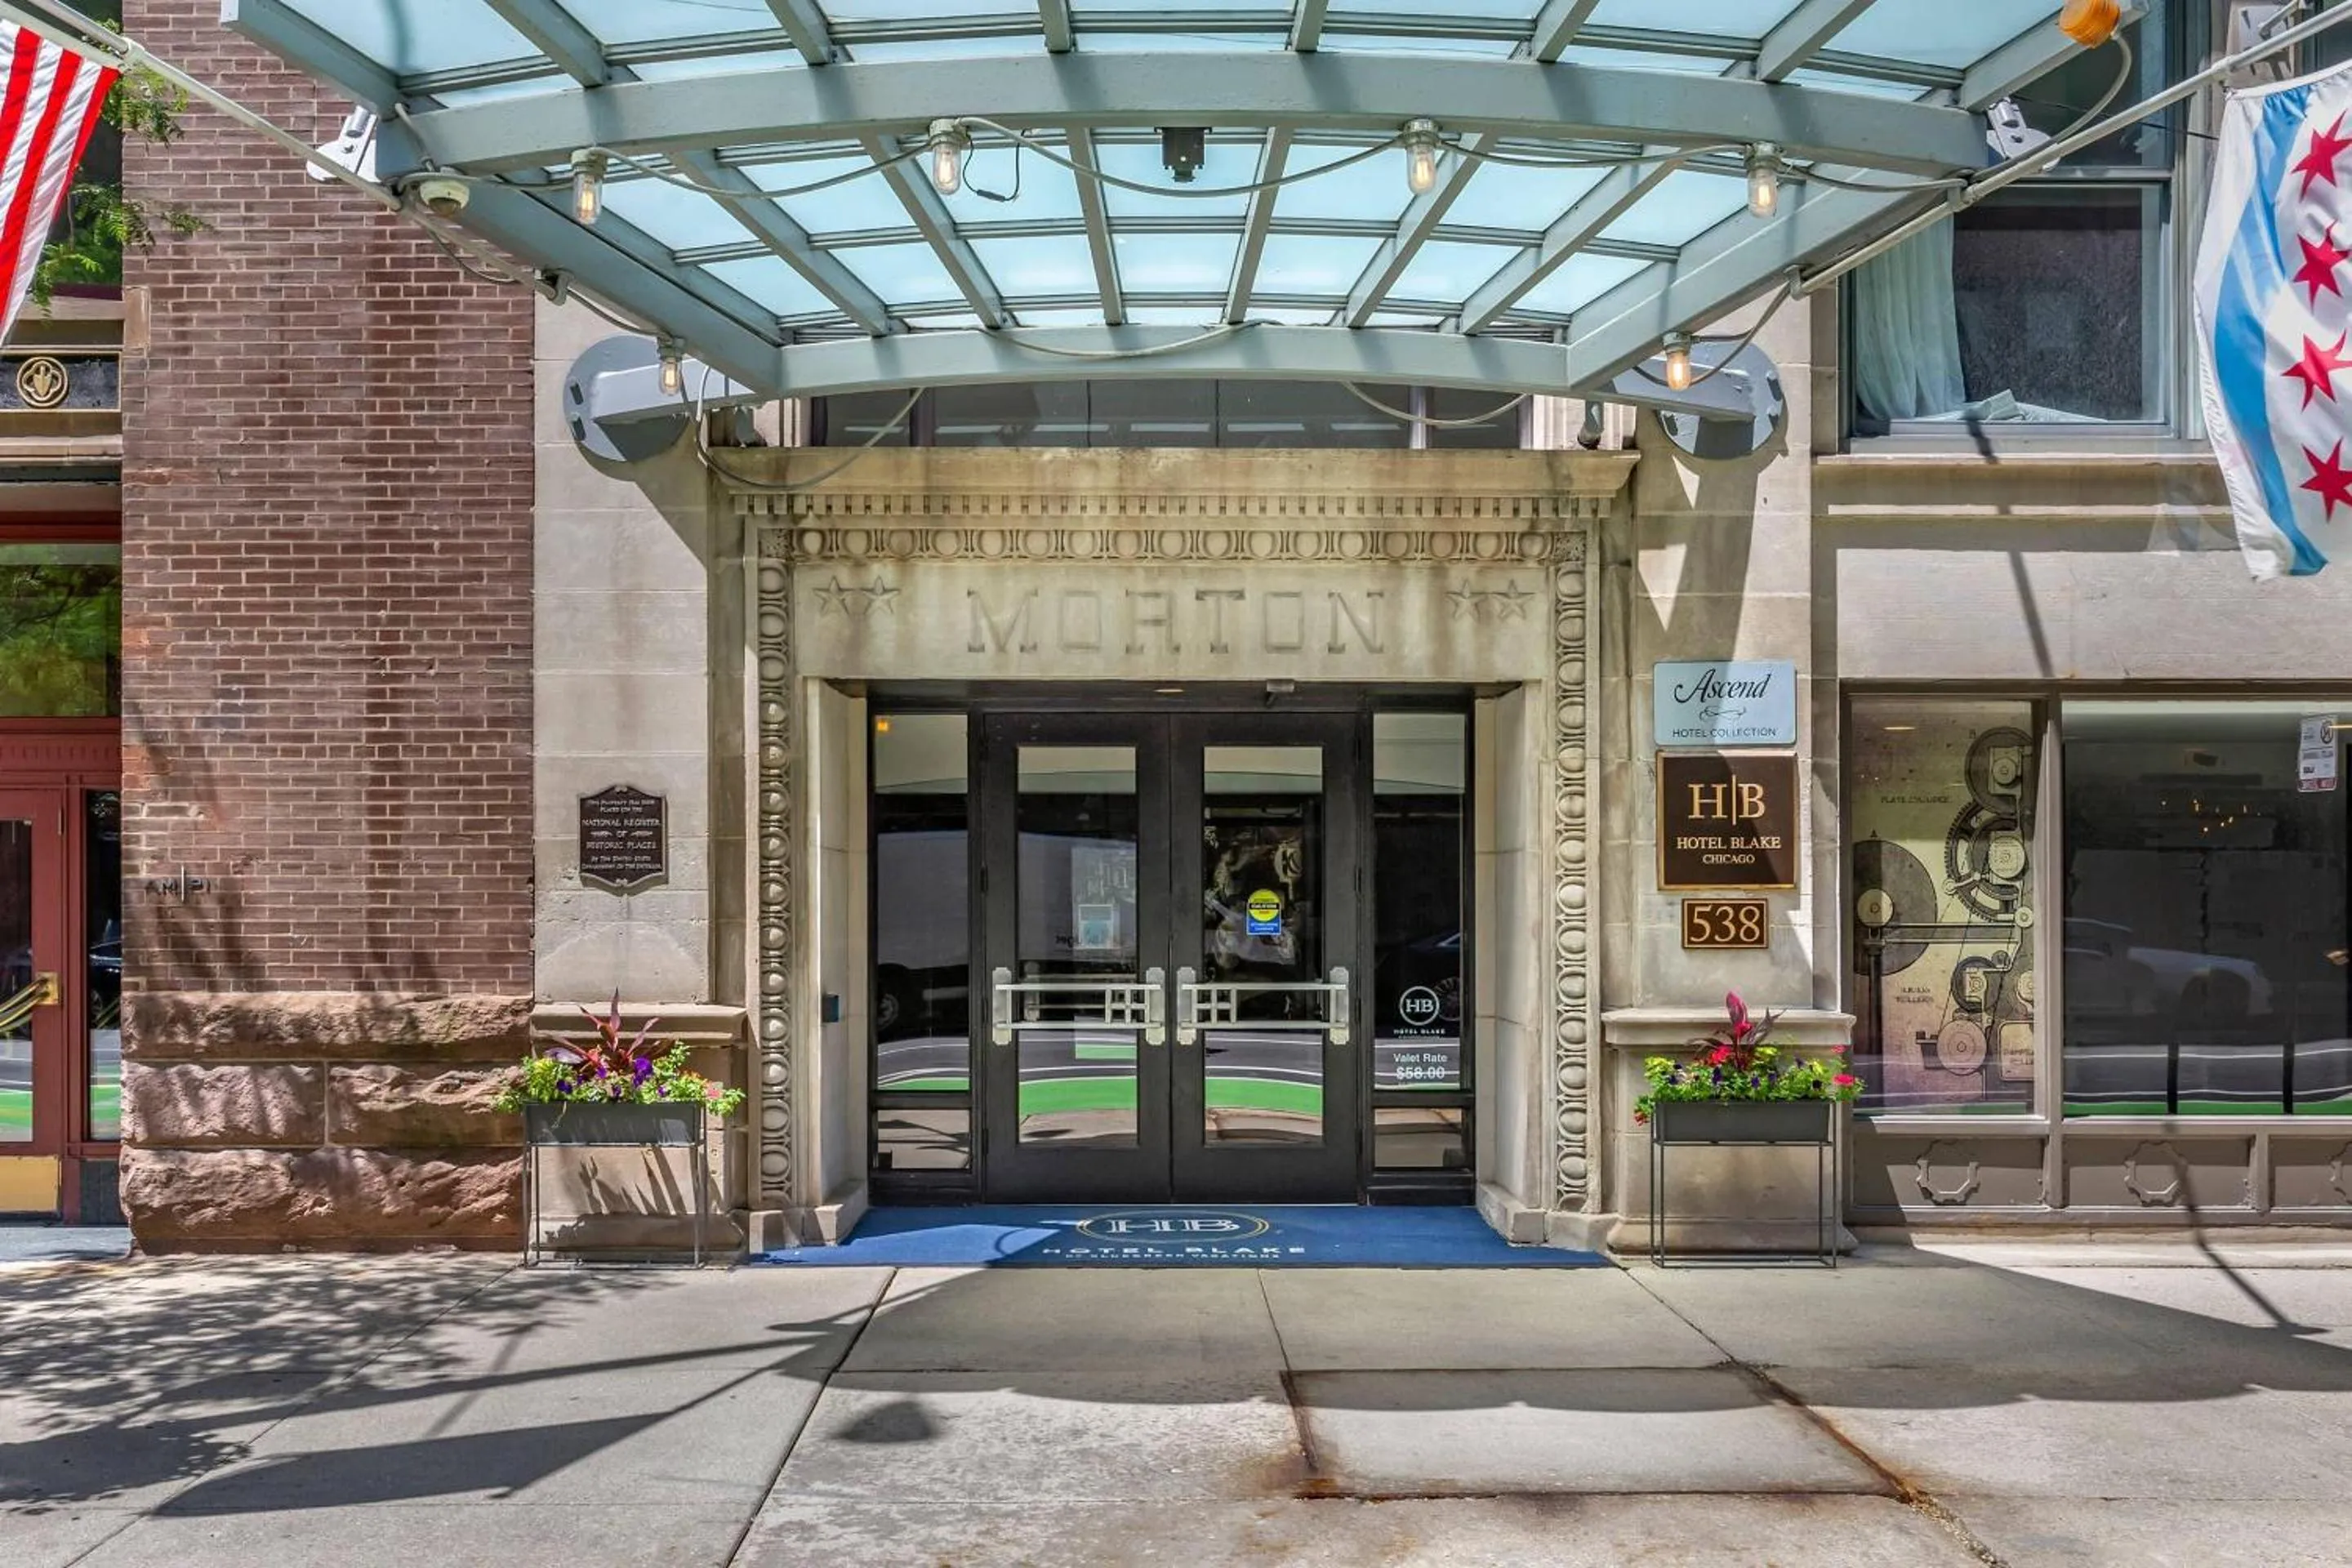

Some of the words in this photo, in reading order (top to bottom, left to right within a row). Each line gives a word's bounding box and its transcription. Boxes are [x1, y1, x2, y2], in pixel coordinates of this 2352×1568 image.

[967, 588, 1384, 653] MORTON
[1674, 668, 1772, 703] Ascend
[1673, 728, 1707, 738] HOTEL
[1710, 727, 1776, 737] COLLECTION
[581, 818, 621, 827] NATIONAL
[1677, 836, 1727, 849] HOTEL
[1731, 835, 1782, 849] BLAKE
[1703, 853, 1756, 864] CHICAGO
[1689, 903, 1761, 942] 538
[1405, 998, 1434, 1013] HB
[1393, 1053, 1420, 1062] Valet
[1423, 1053, 1448, 1062] Rate
[1396, 1066, 1446, 1080] $58.00
[1107, 1218, 1241, 1234] HB
[1042, 1246, 1166, 1254] HOTEL
